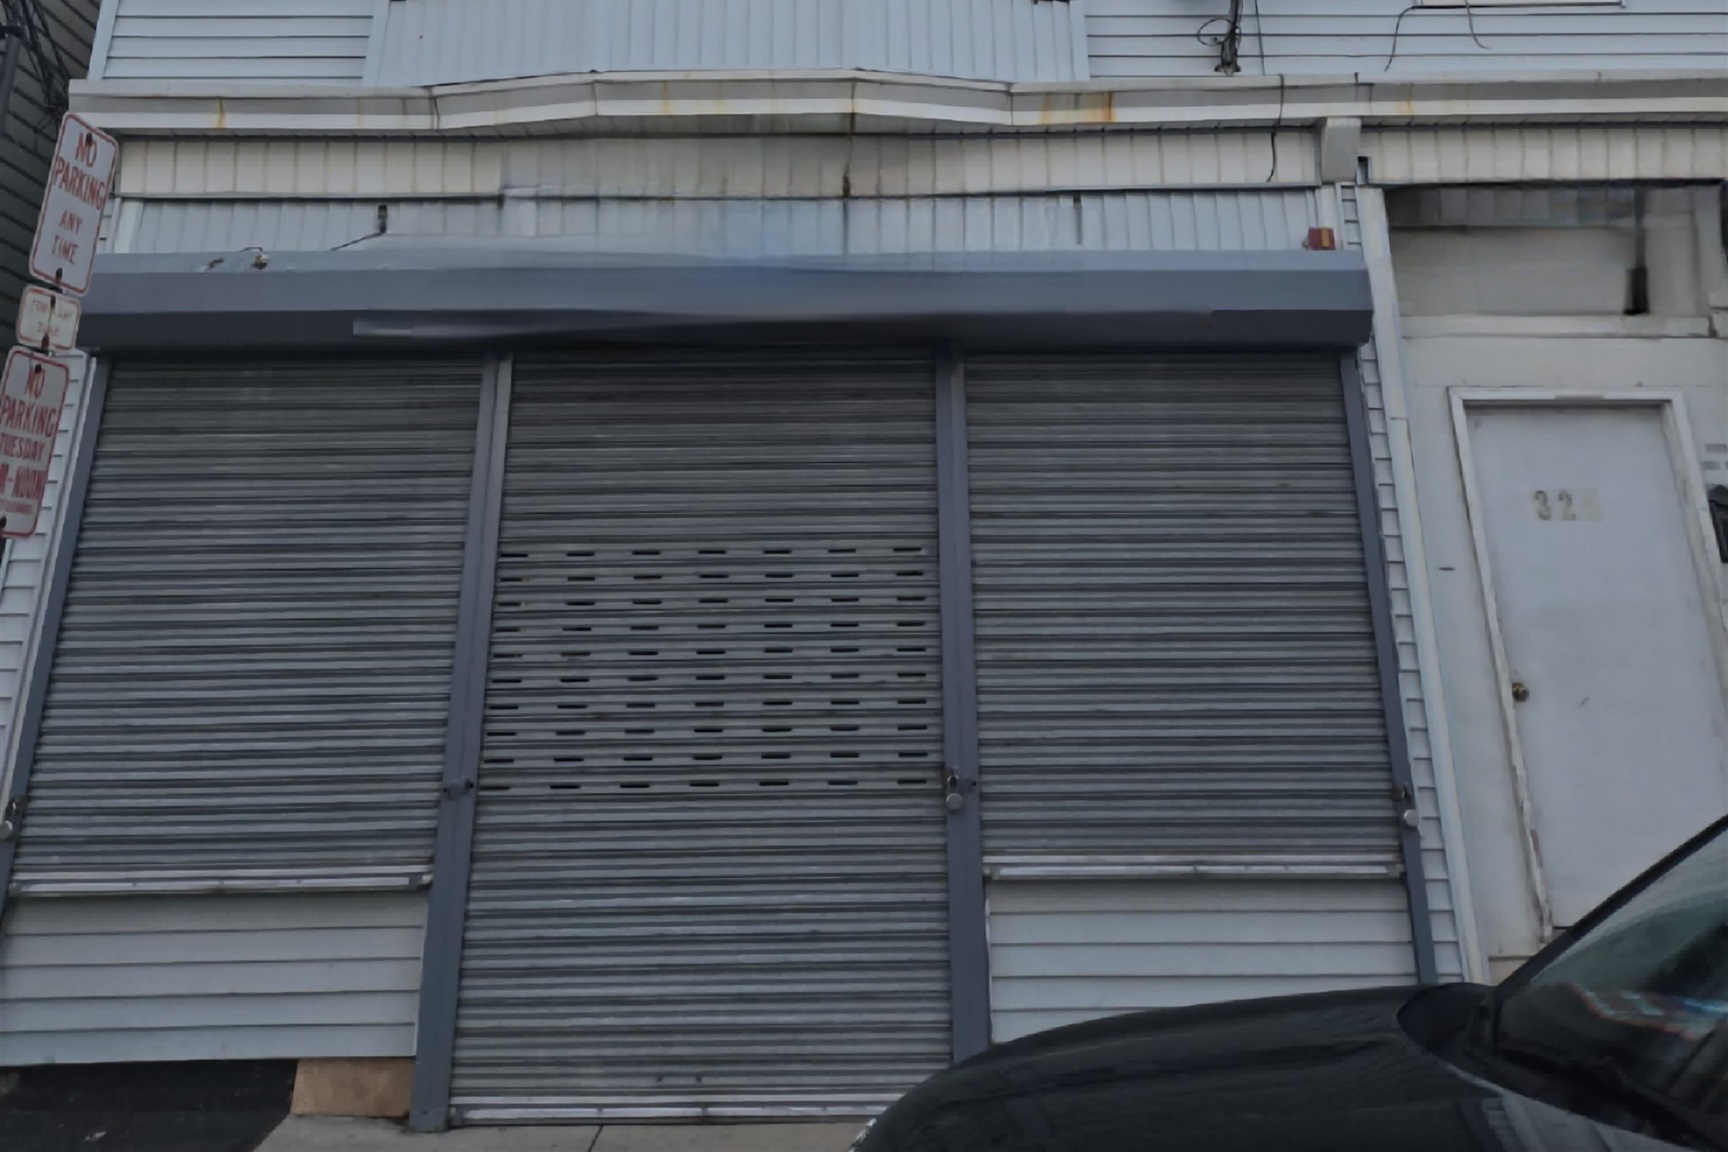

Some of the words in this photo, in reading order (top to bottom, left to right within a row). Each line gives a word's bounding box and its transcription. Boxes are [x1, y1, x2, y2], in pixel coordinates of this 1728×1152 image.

[75, 132, 98, 168] NO
[51, 157, 106, 209] PARKING
[58, 209, 83, 235] ANY
[52, 235, 79, 265] TIME
[24, 367, 46, 399] NO
[0, 394, 57, 437] PARKING
